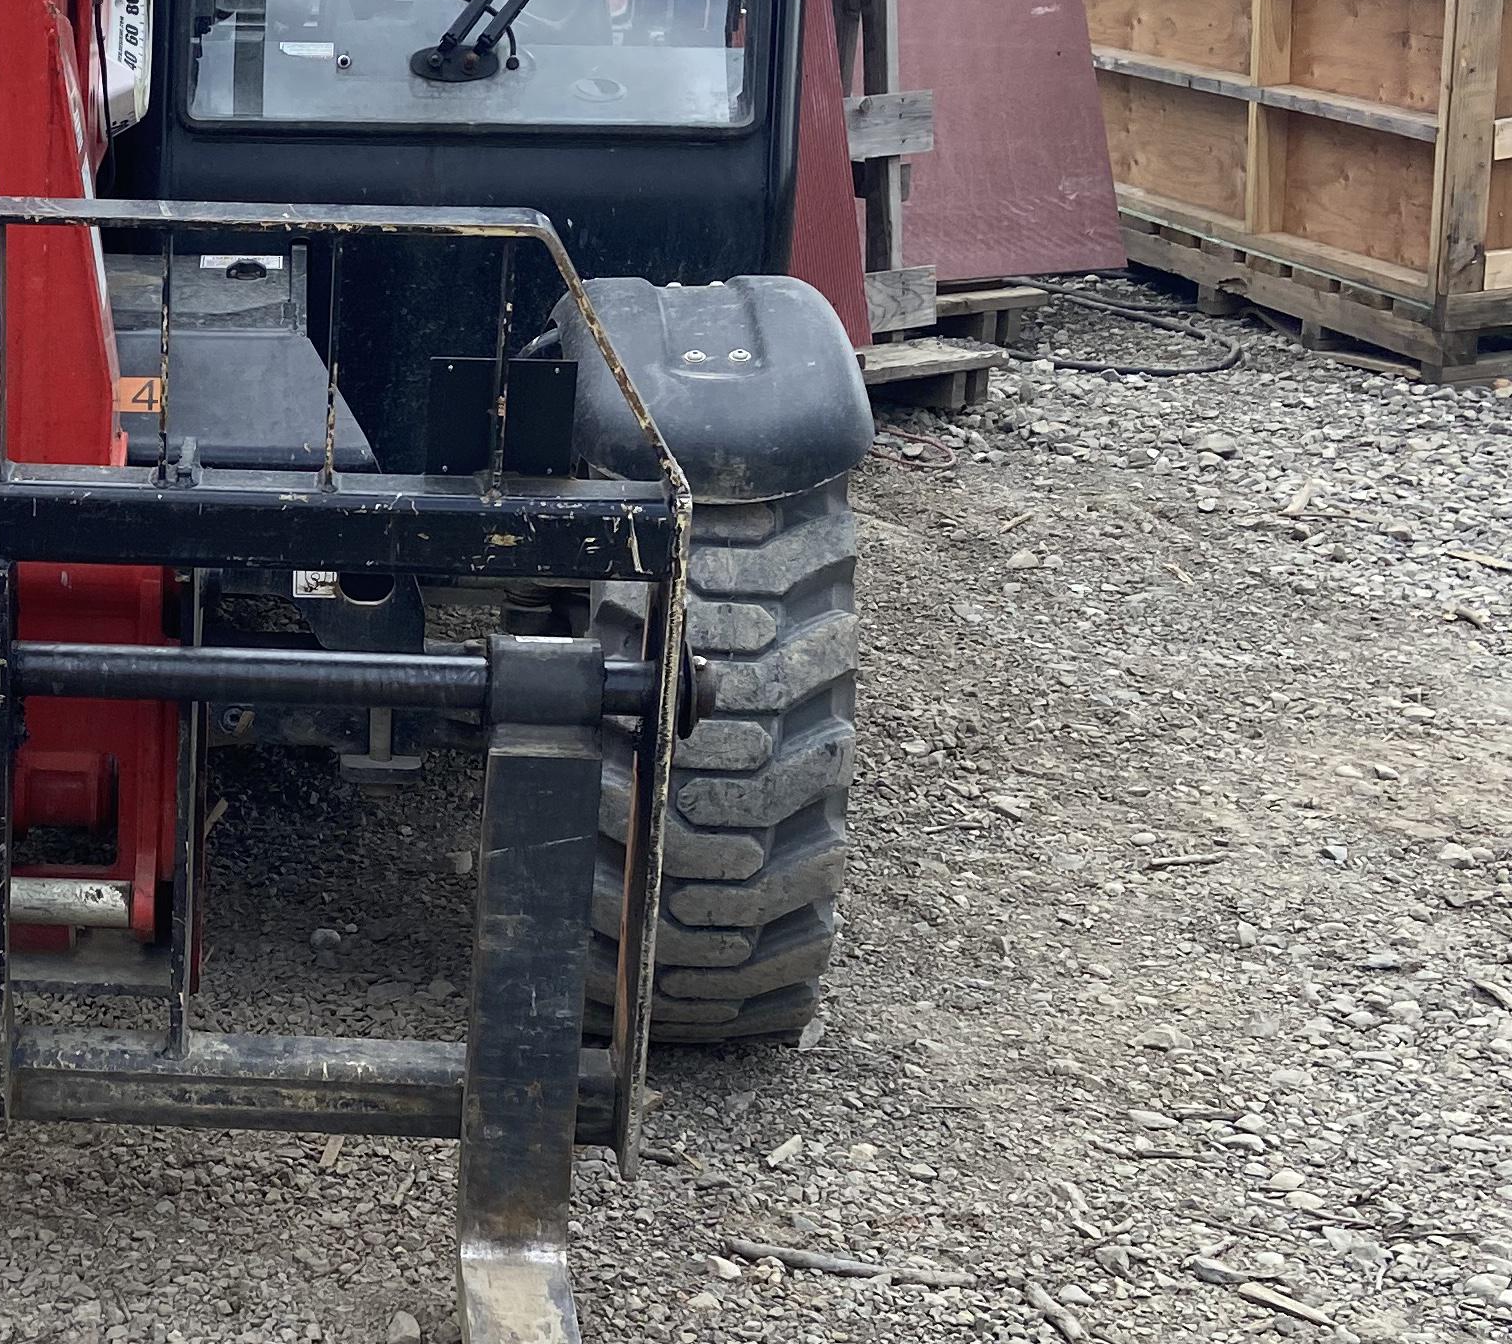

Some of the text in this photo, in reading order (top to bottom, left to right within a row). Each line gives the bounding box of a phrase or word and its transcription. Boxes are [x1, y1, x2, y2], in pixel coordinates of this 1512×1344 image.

[125, 24, 138, 47] 60
[124, 50, 137, 71] 40
[131, 379, 159, 411] 4
